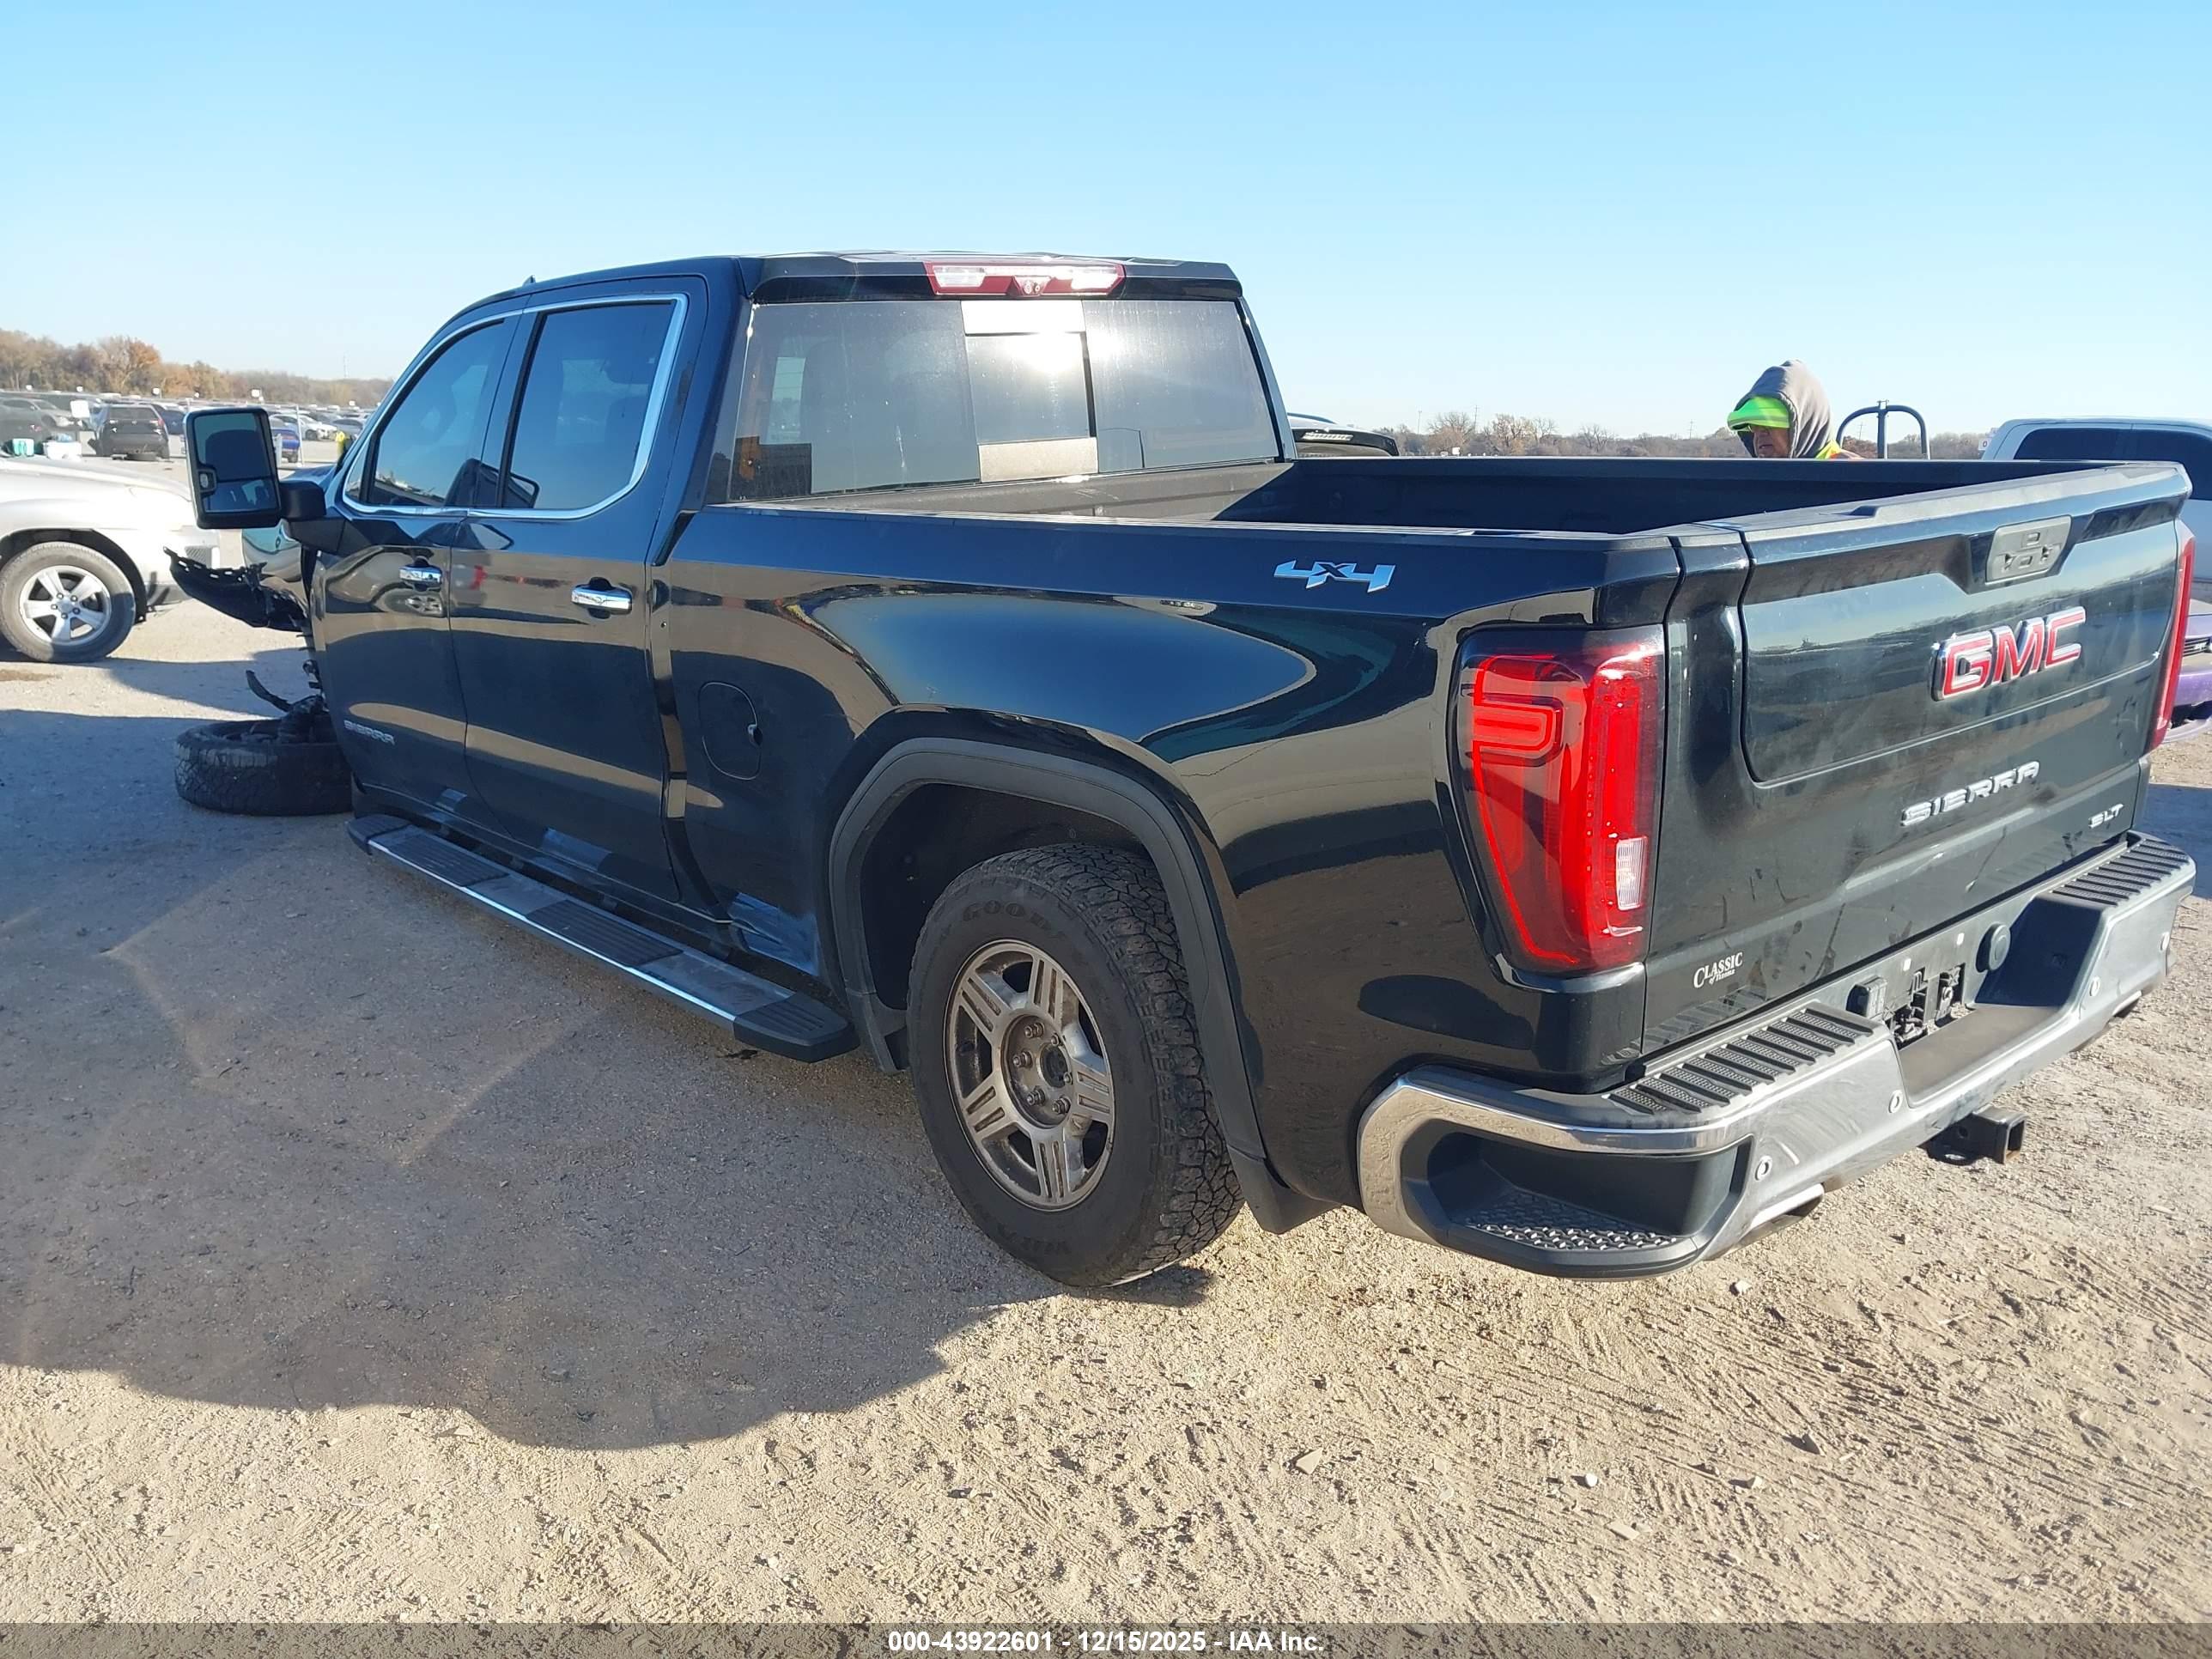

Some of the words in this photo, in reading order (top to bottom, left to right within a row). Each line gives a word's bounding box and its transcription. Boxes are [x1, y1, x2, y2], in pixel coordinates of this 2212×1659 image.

[1931, 606, 2086, 702] GMC
[1900, 761, 2040, 826] SIERRA
[2088, 804, 2124, 829] SLT
[1693, 951, 1743, 988] CLASSIC
